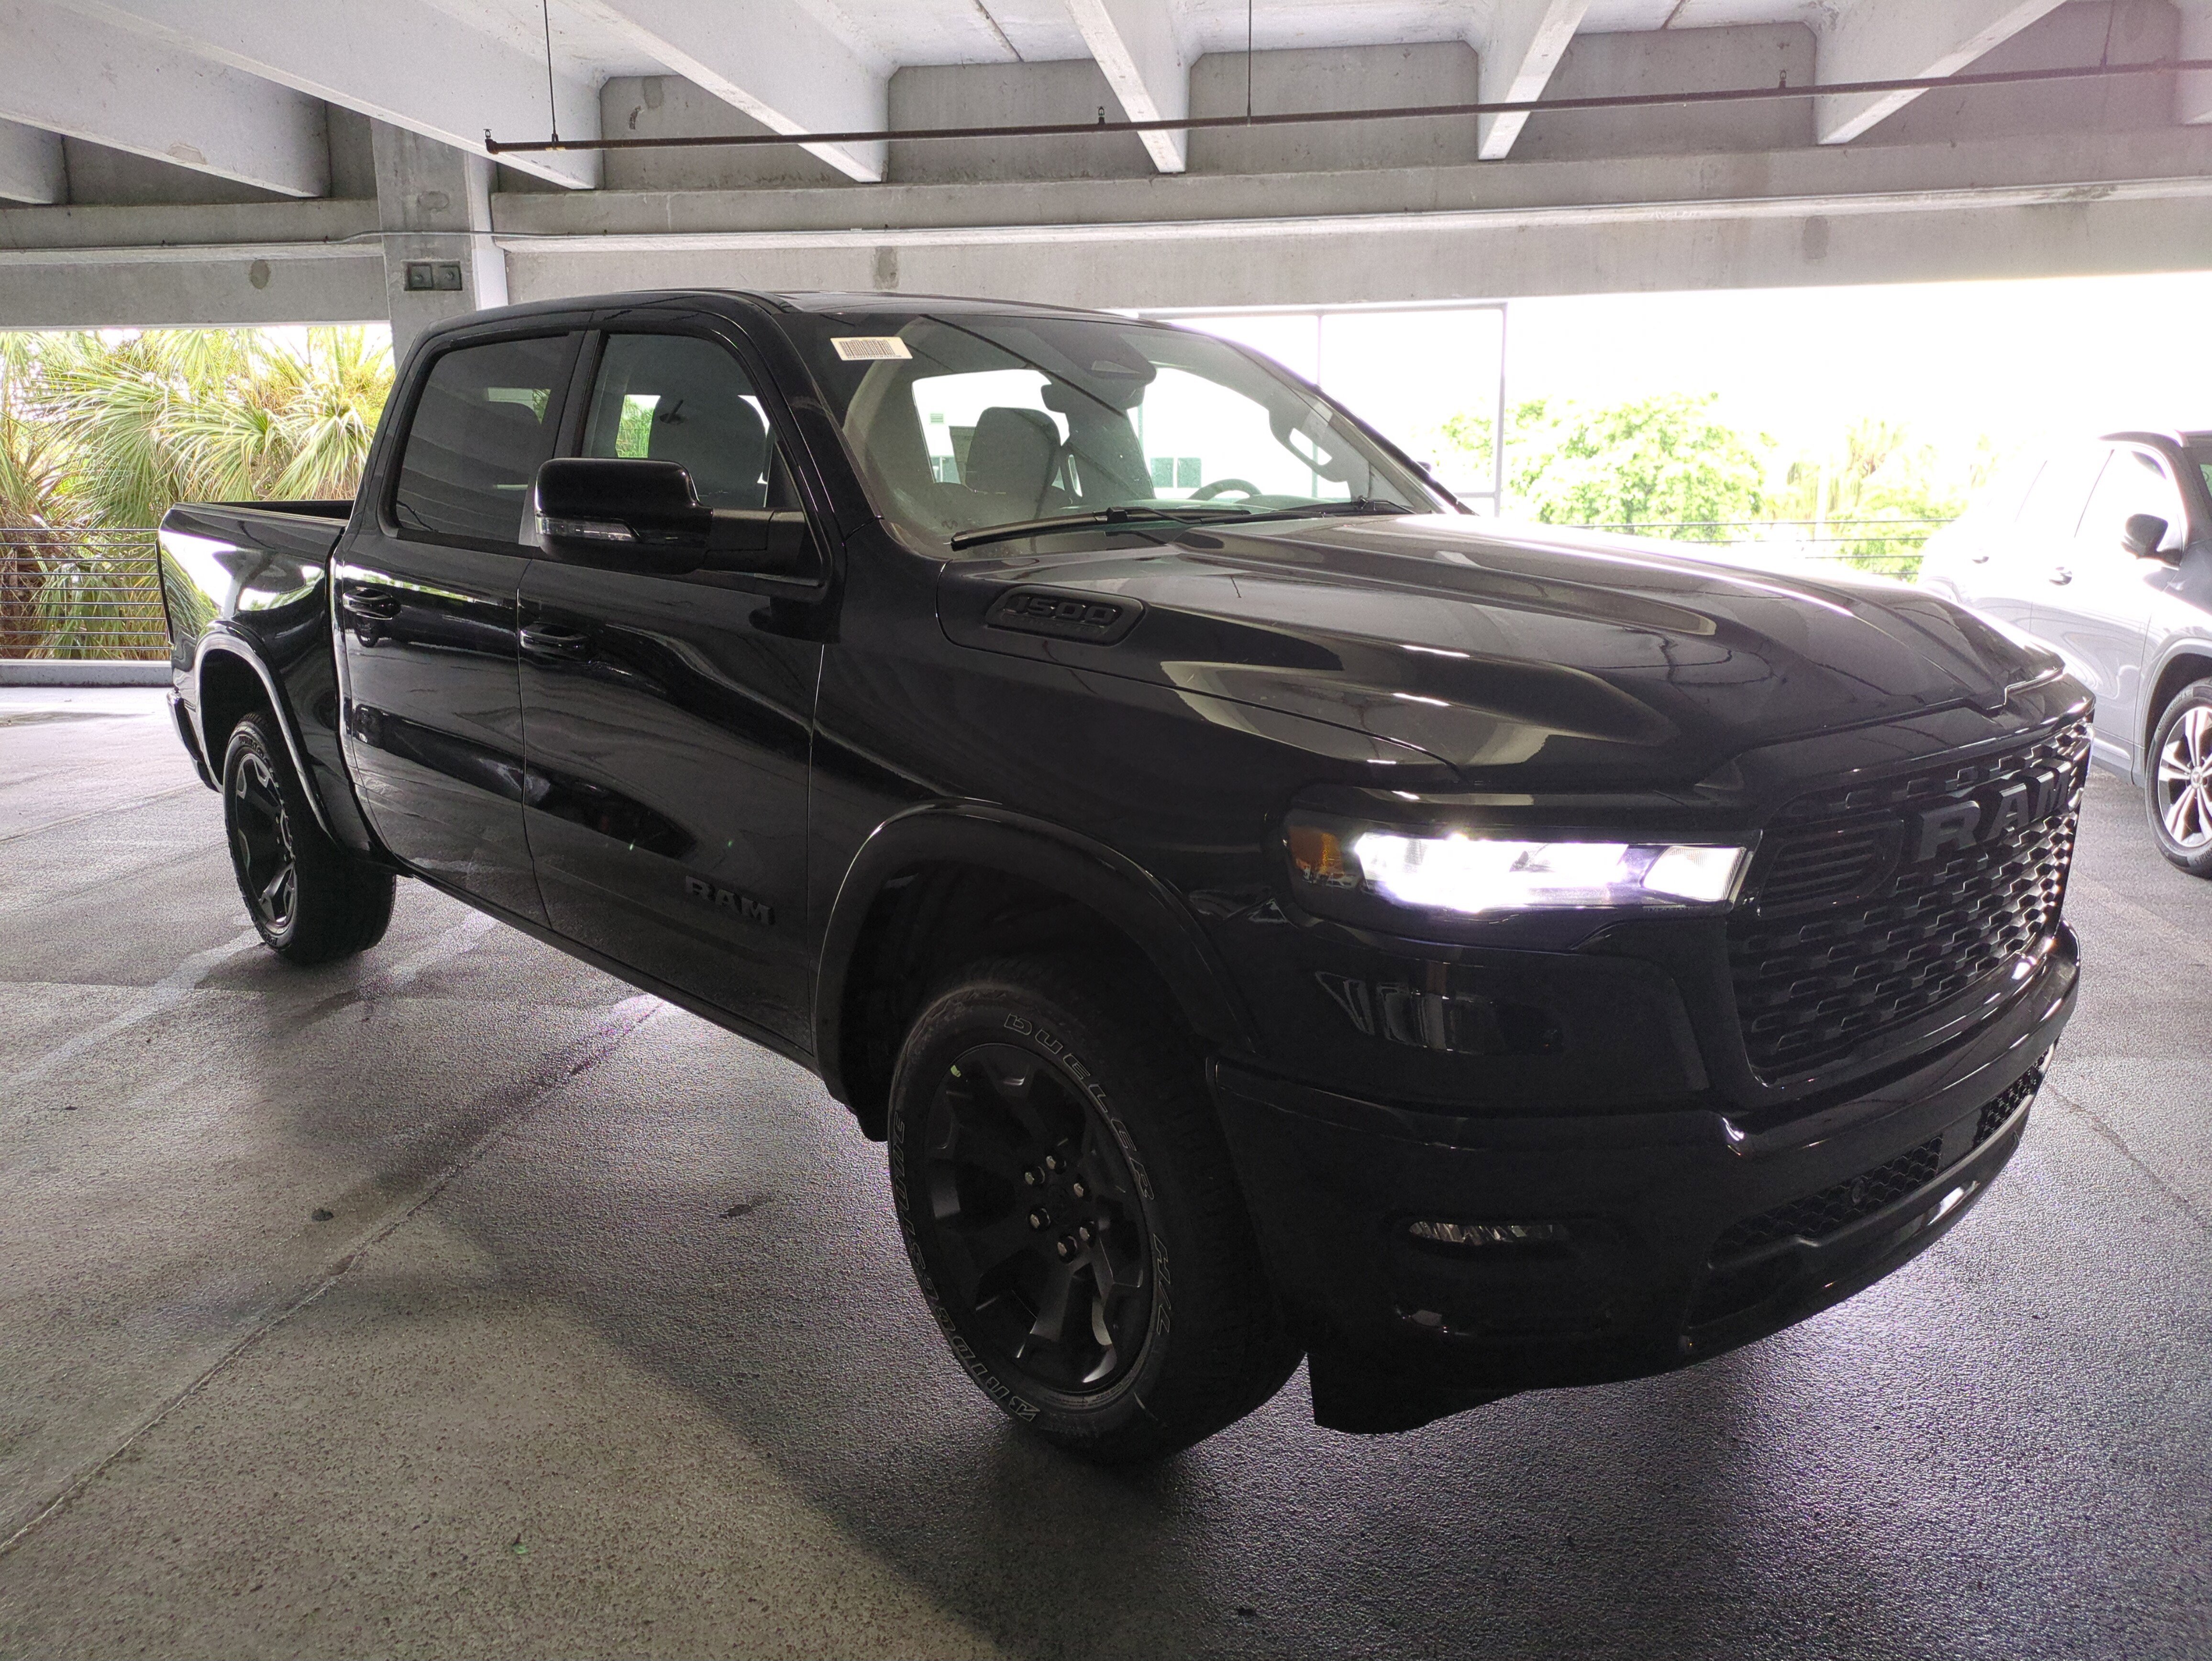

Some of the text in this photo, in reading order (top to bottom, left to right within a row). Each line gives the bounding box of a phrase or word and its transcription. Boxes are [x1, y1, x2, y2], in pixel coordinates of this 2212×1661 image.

[1013, 596, 1117, 624] 1500
[1914, 761, 2073, 863] RAM
[686, 875, 773, 924] RAM
[1004, 1013, 1154, 1200] DUELER
[891, 1111, 1040, 1422] BRIDGESTONE
